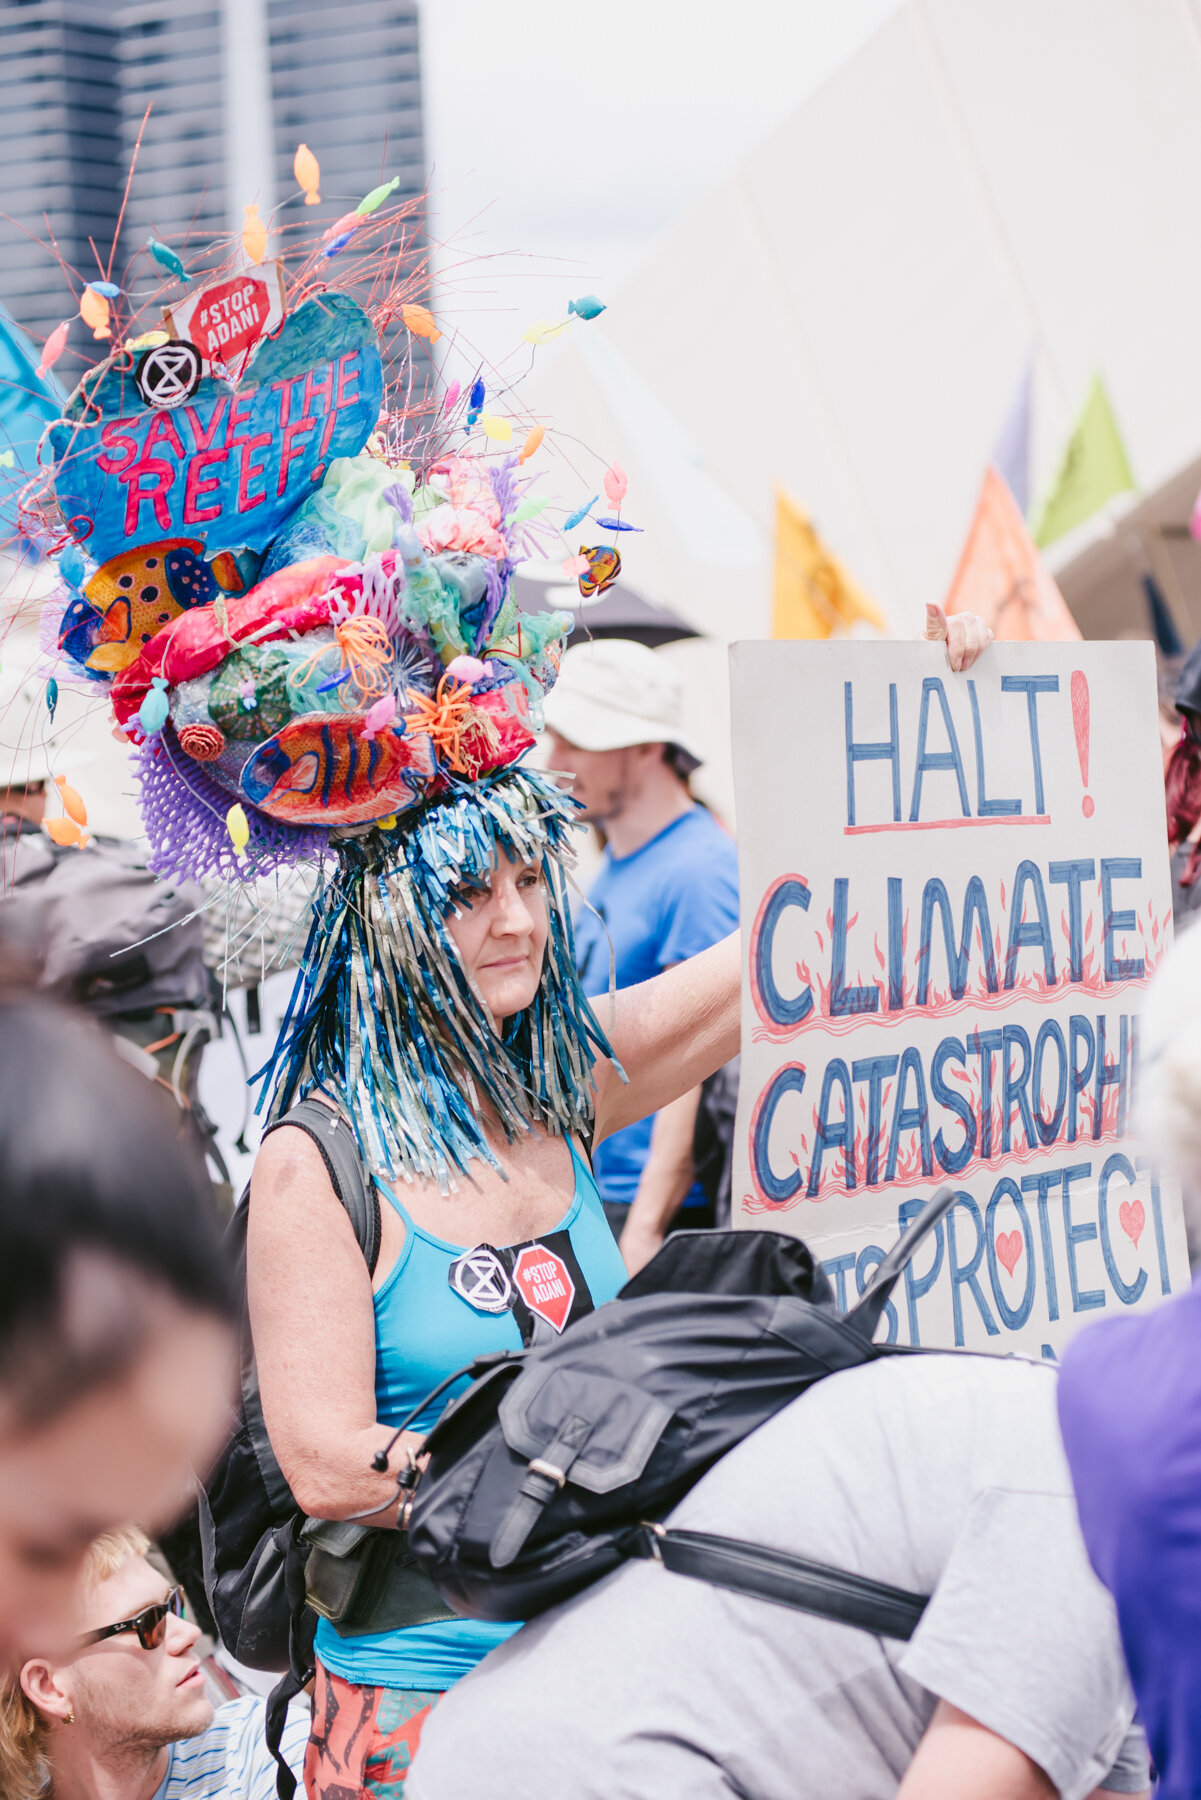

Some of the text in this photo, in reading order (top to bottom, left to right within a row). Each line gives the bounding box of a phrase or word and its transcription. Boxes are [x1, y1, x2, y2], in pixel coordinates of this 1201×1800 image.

[200, 284, 254, 328] #STOP
[207, 303, 260, 353] ADANI
[96, 350, 360, 475] SAVE THE
[119, 409, 338, 538] REEF!
[844, 669, 1095, 826] HALT!
[750, 858, 1146, 1028] CLIMATE
[522, 1260, 557, 1284] #STOP
[532, 1278, 566, 1304] ADANI
[899, 1153, 1171, 1347] PROTECT
